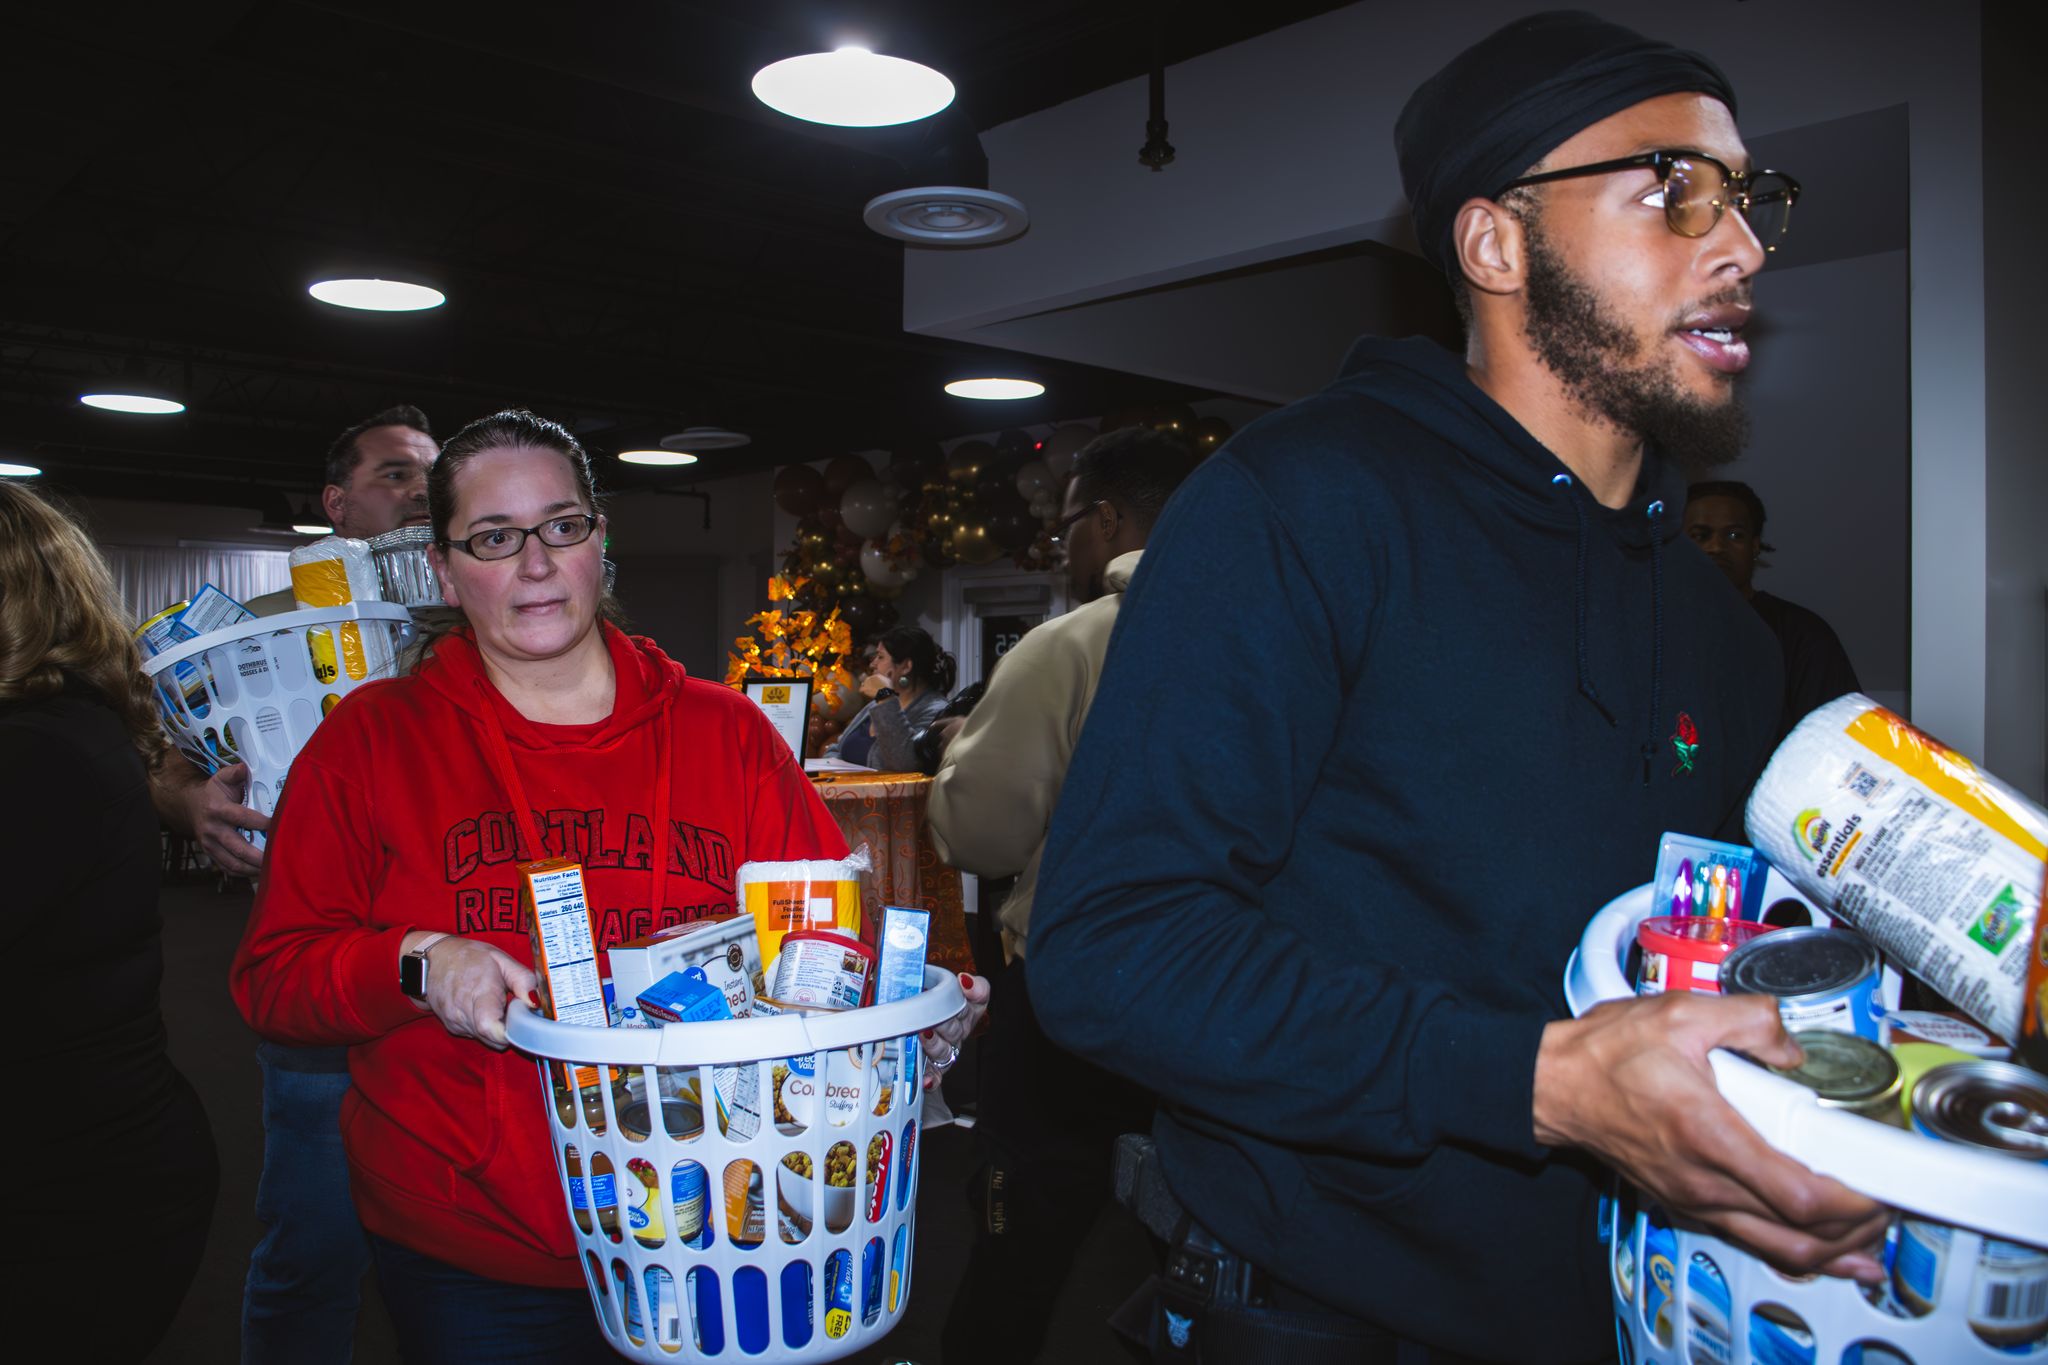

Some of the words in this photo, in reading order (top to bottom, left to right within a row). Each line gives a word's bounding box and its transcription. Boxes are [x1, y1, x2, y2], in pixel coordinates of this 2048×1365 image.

[444, 808, 736, 895] CORTLAND
[1816, 813, 1862, 878] essentials
[533, 874, 561, 883] Nutrition
[562, 870, 579, 878] Facts
[456, 887, 529, 935] RE
[724, 977, 744, 990] Instant
[798, 1060, 815, 1070] Valu
[829, 1099, 854, 1112] Stuffing
[833, 1314, 844, 1338] FREE
